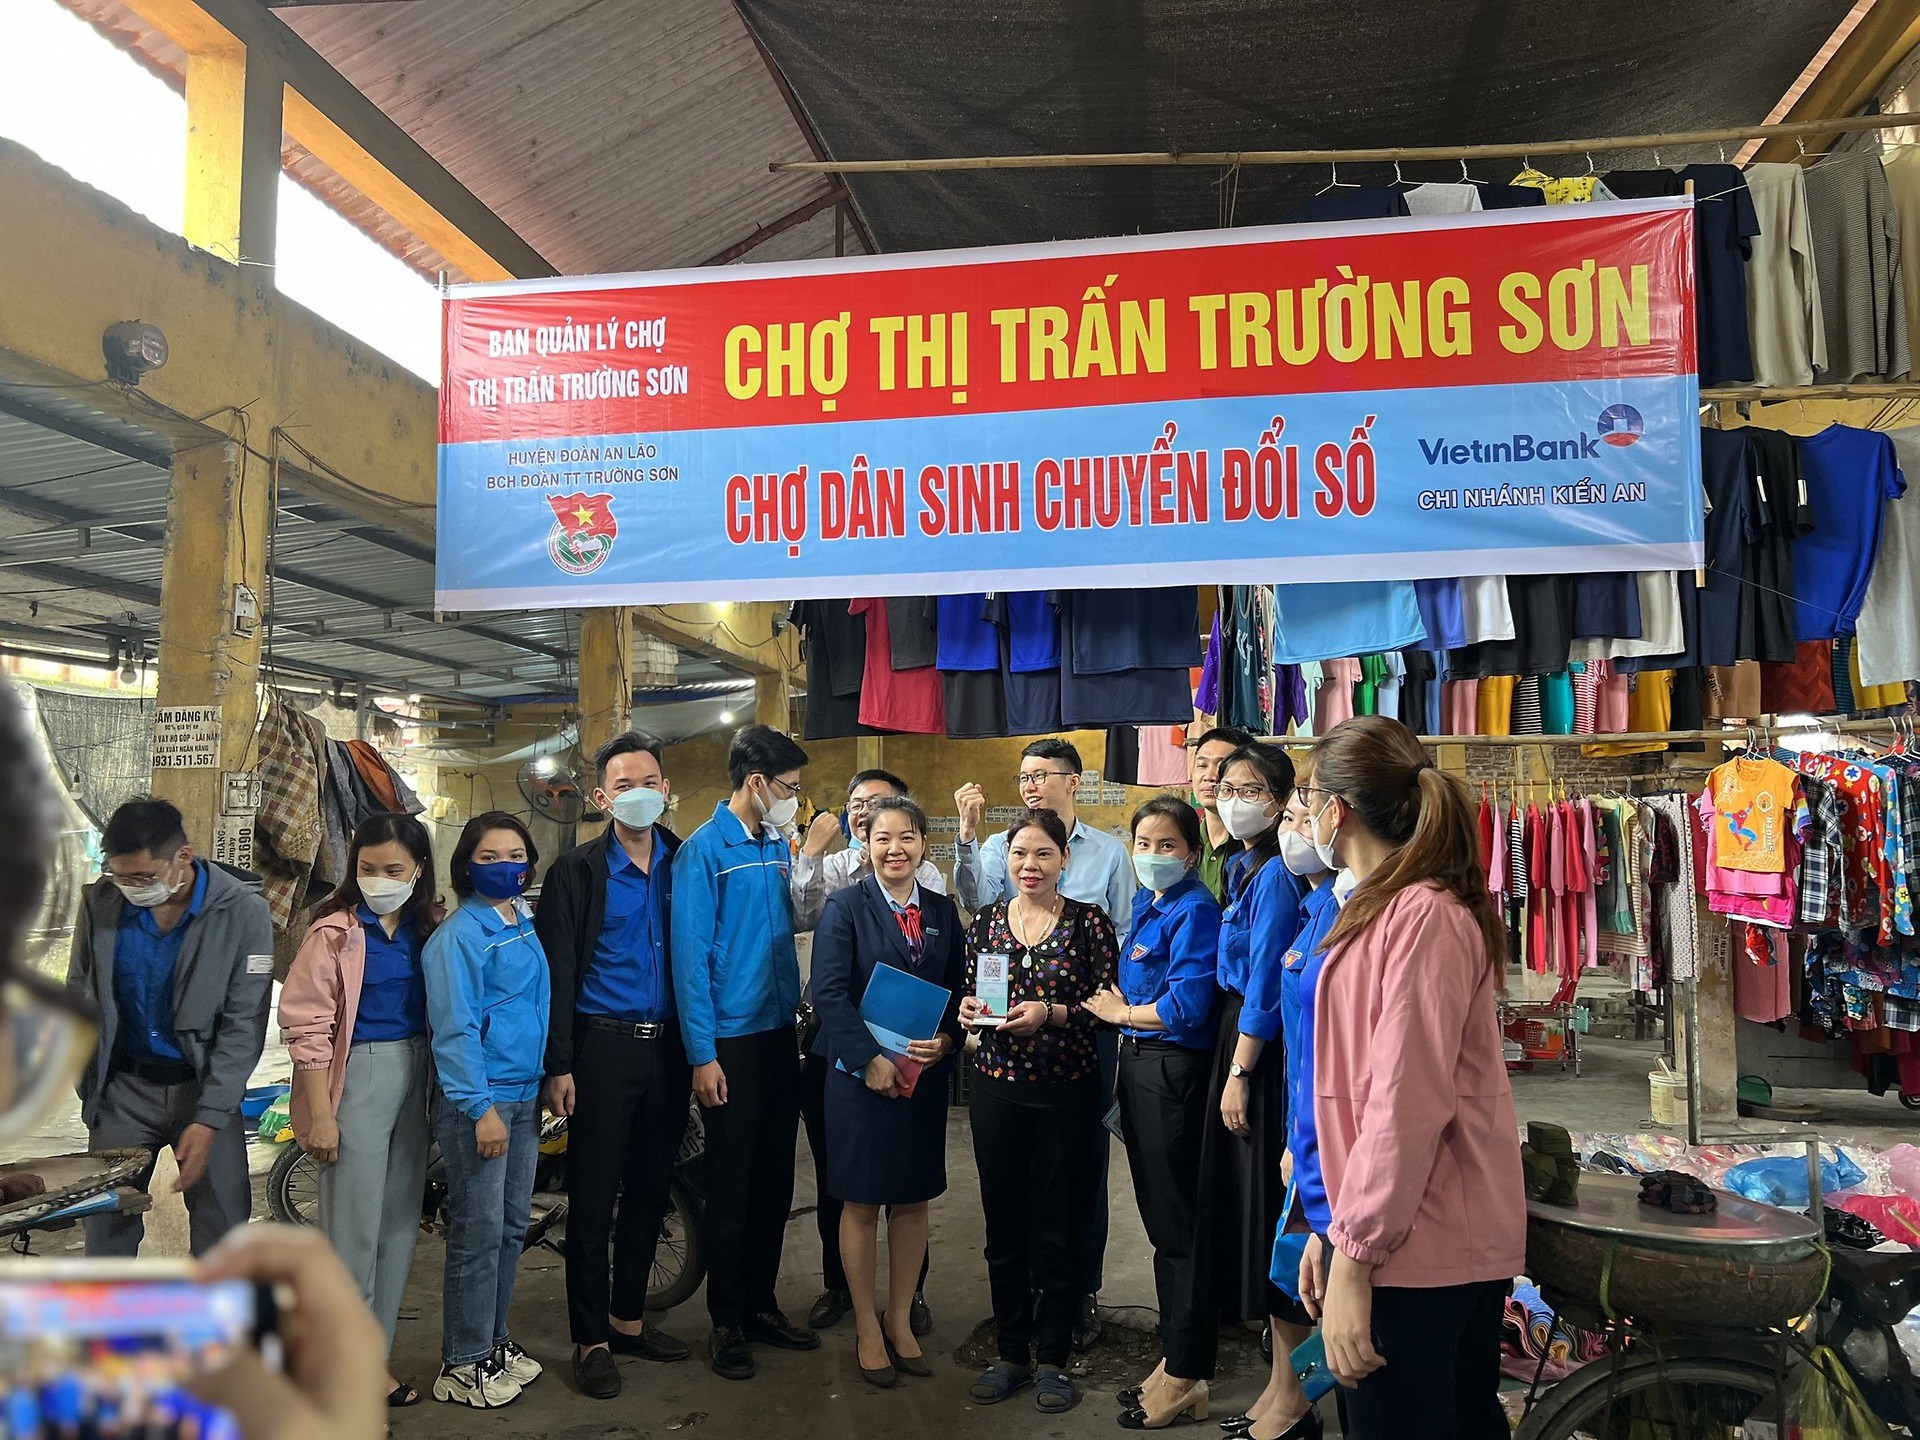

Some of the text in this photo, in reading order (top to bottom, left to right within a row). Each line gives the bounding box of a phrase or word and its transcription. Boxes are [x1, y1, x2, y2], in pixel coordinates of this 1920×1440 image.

[488, 316, 666, 358] BAN QUẢN LÝ CHỢ
[724, 259, 1651, 412] CHỢ THỊ TRẤN TRƯỜNG SƠN
[467, 364, 688, 411] THỊ TRẤN TRƯỜNG SƠN
[508, 443, 656, 467] HUYỆN ĐOÀN AN LÃO
[1418, 432, 1601, 465] VietinBank
[487, 466, 678, 489] BCH ĐOÀN TT TRƯỜNG SƠN
[726, 414, 1378, 558] CHỢ DÂN SINH CHUYỂN ĐỔI SỐ
[1418, 477, 1647, 510] CHI NHÁNH KIẾN AN
[175, 709, 201, 722] ĐĂNG
[215, 830, 226, 859] THÁNG
